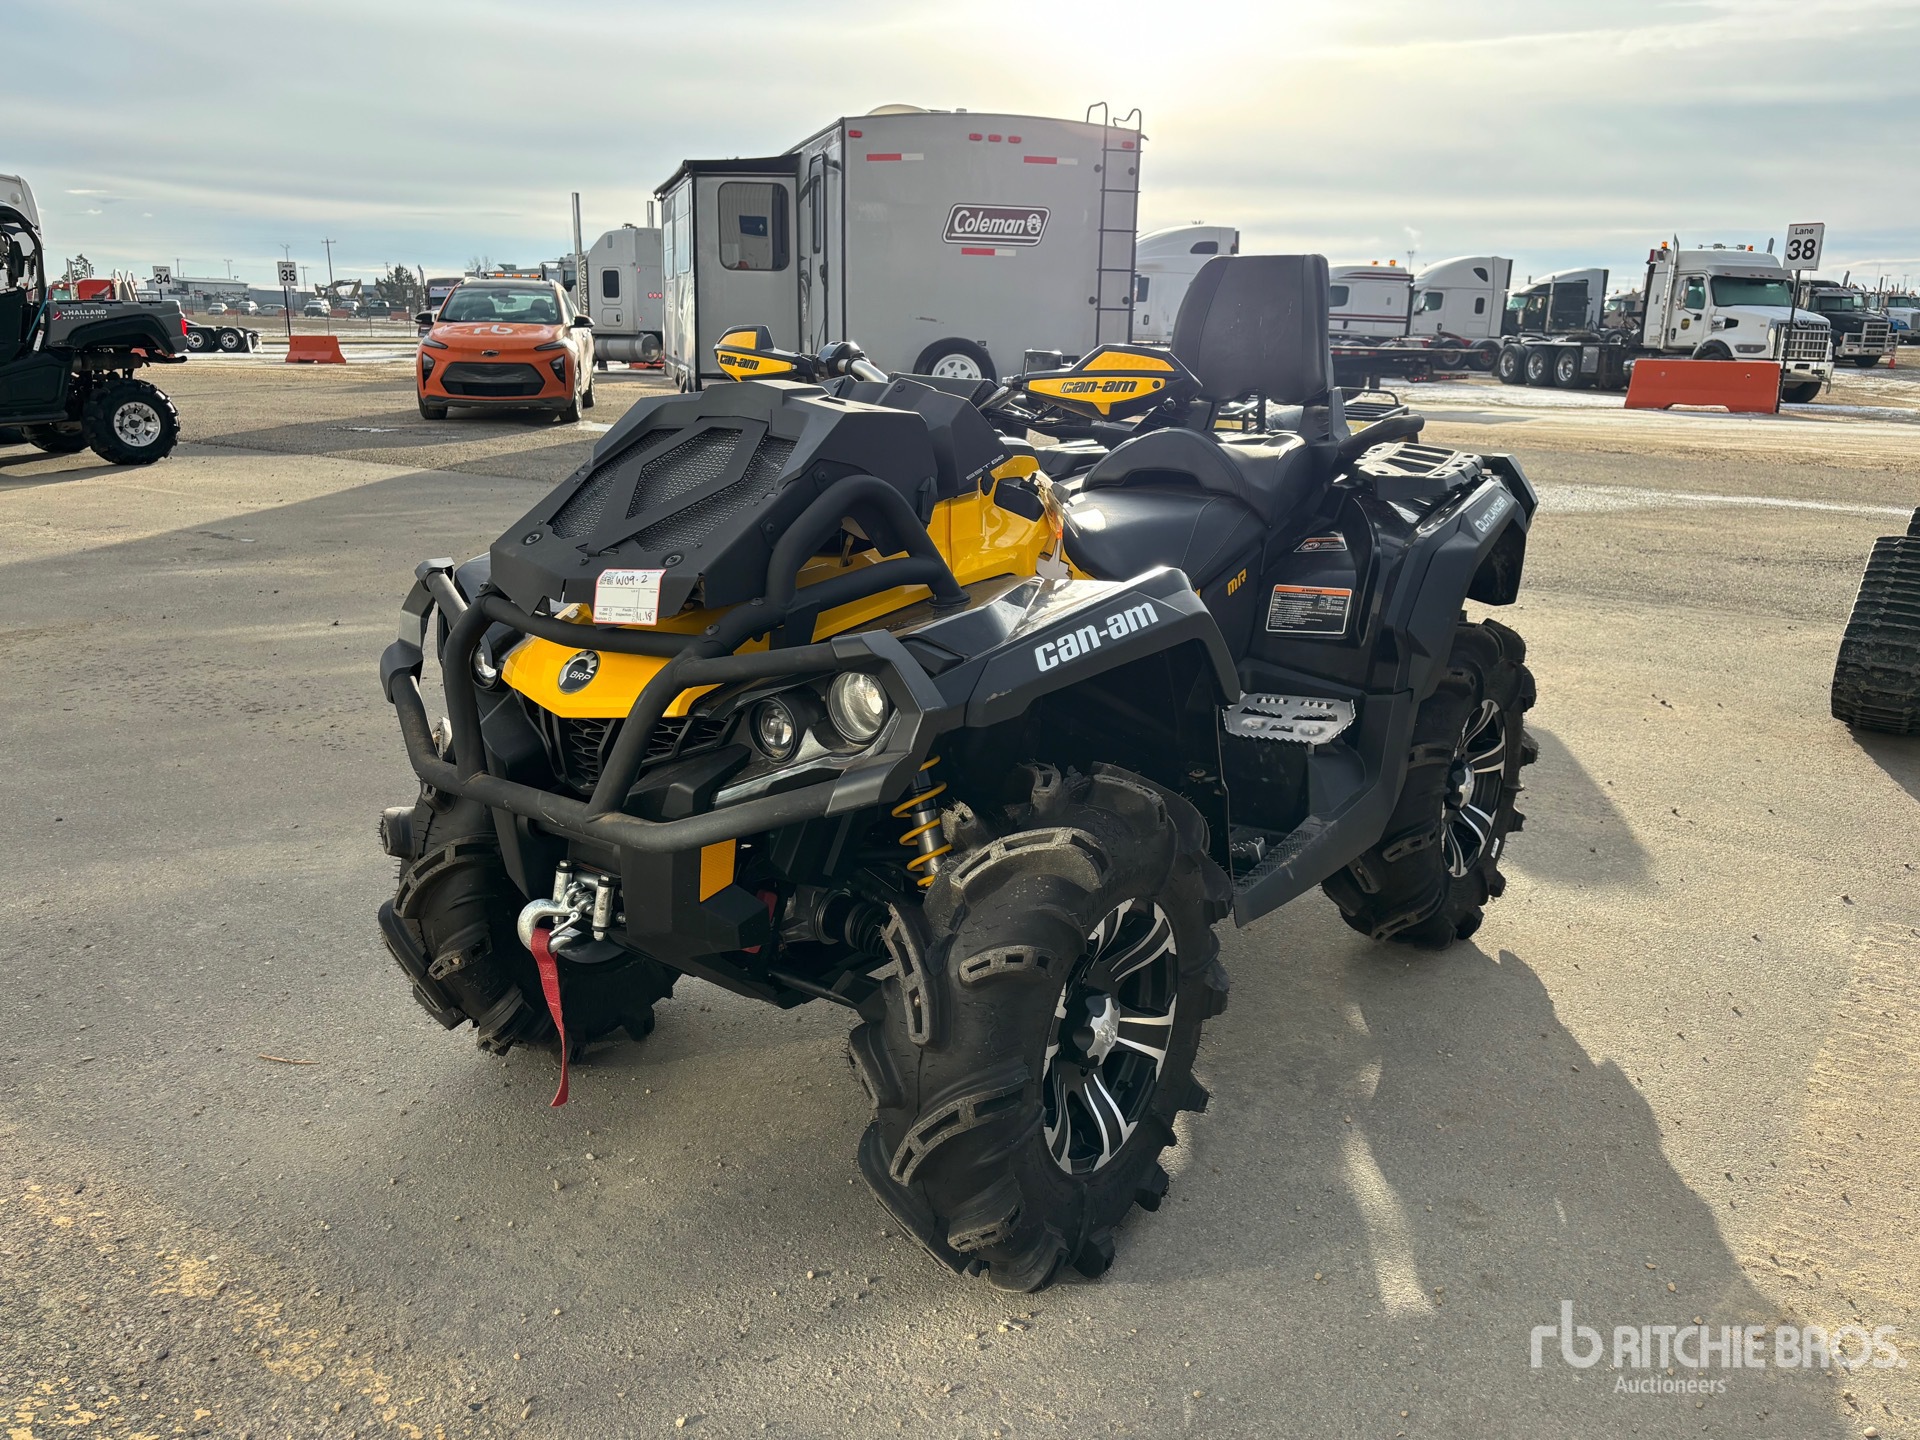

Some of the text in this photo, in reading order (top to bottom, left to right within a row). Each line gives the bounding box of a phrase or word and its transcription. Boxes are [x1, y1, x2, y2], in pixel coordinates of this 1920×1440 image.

[953, 210, 1026, 234] Coleman
[1794, 227, 1814, 235] Lane
[1787, 238, 1816, 261] 38
[155, 273, 170, 284] 34
[281, 269, 296, 282] 35
[473, 324, 514, 335] rb
[719, 354, 760, 371] can-am
[1060, 380, 1138, 394] can-am
[1474, 495, 1509, 533] OUTLANDER
[1034, 602, 1159, 672] can-am
[569, 670, 592, 681] BRP
